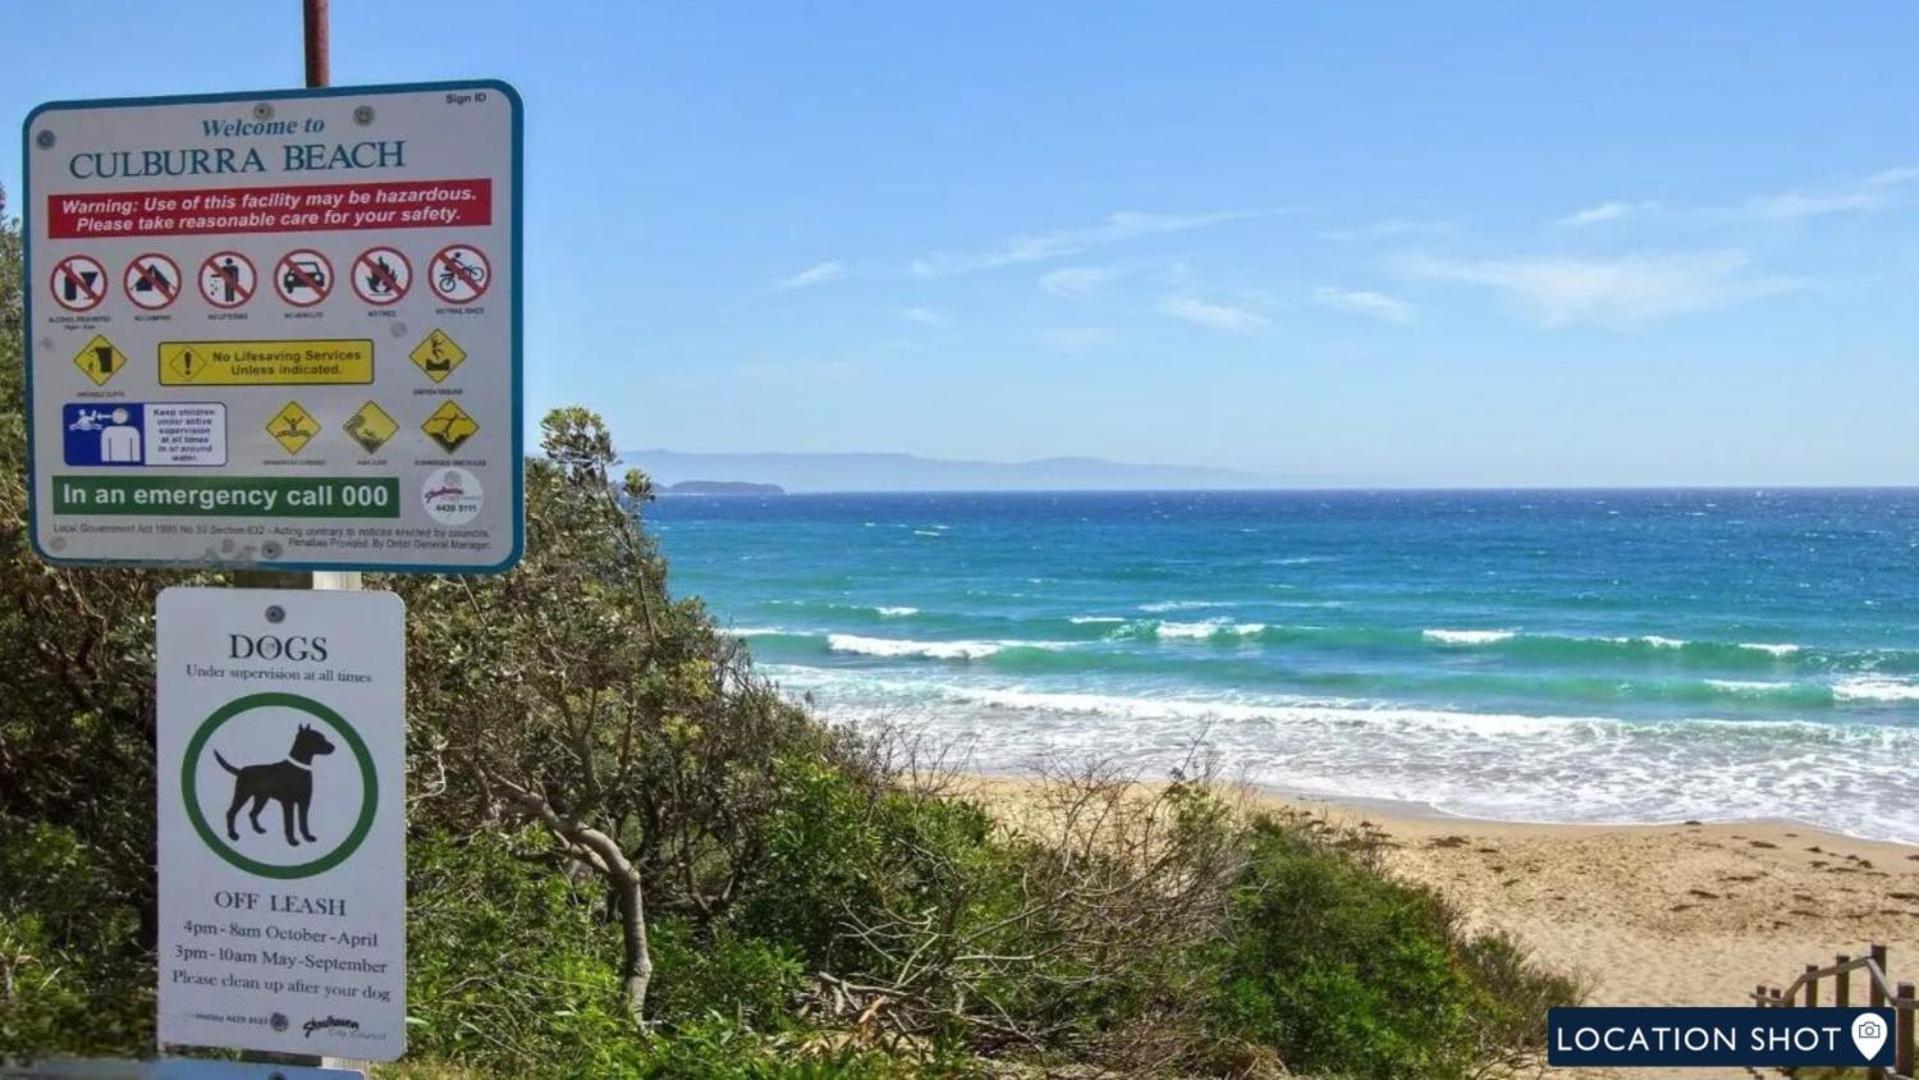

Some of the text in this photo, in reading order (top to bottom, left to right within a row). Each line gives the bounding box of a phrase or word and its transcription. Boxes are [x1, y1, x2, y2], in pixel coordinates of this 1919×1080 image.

[446, 93, 487, 105] Sign ID
[202, 117, 325, 137] Welcome to
[69, 140, 407, 179] CULBURRA BEACH
[62, 187, 477, 215] Warning: Use of this facility may be hazardous.
[76, 206, 461, 232] Please take reasonable care for your safety.
[212, 350, 361, 364] No Lifesaving Services
[230, 365, 275, 376] Unless
[63, 484, 388, 510] In an emergency call 000
[228, 634, 328, 662] DOGS
[186, 663, 372, 683] Under supervision at all times
[214, 890, 346, 916] OFF LEASH
[172, 969, 391, 1003] Please clean up after your dog
